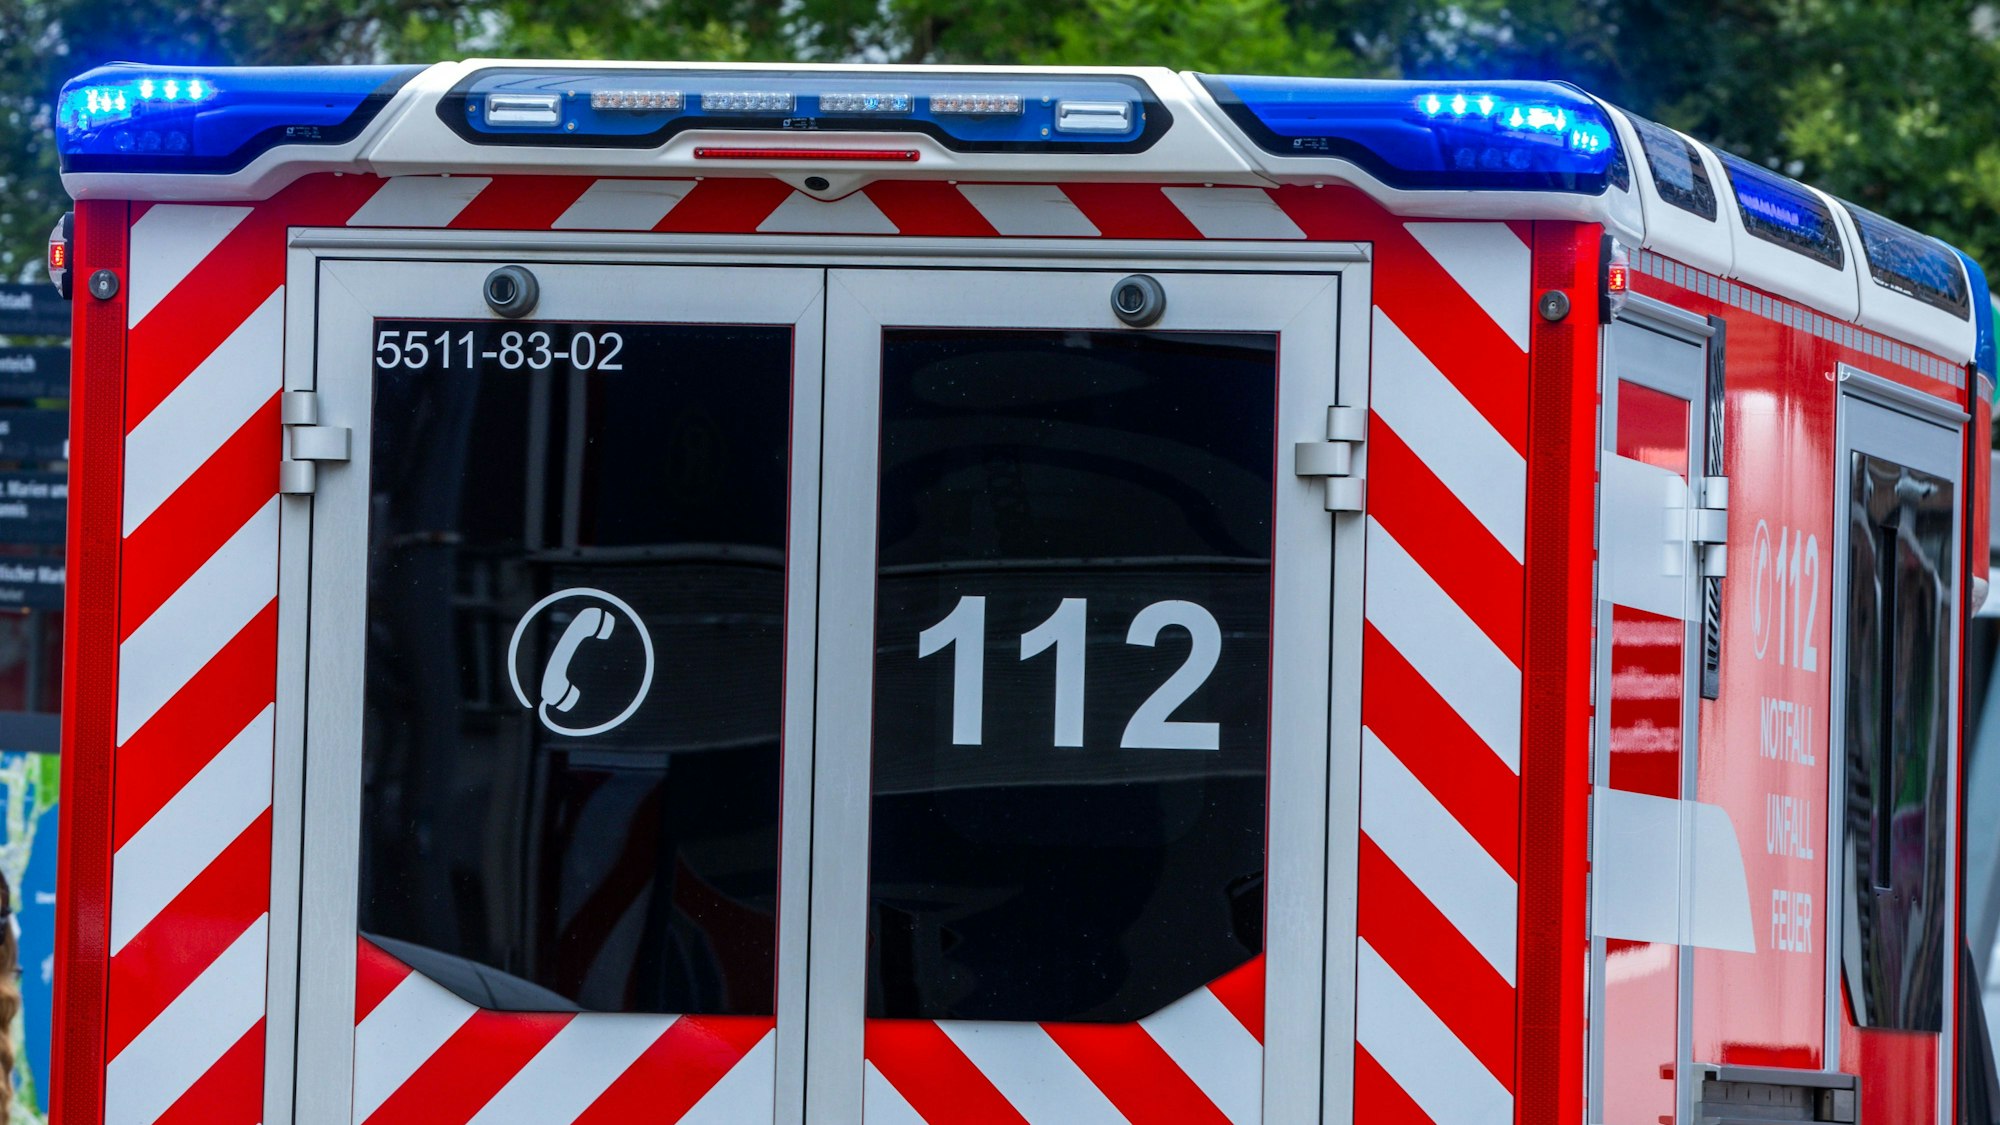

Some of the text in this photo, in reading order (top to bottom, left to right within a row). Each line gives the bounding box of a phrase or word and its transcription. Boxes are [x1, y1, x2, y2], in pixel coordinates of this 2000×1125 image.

[376, 331, 623, 370] 5511-83-02
[1776, 526, 1818, 673] 112
[919, 596, 1222, 751] 112
[1760, 696, 1815, 767] NOTFALL
[1767, 793, 1814, 860] UNFALL
[1771, 888, 1812, 954] FEUER
